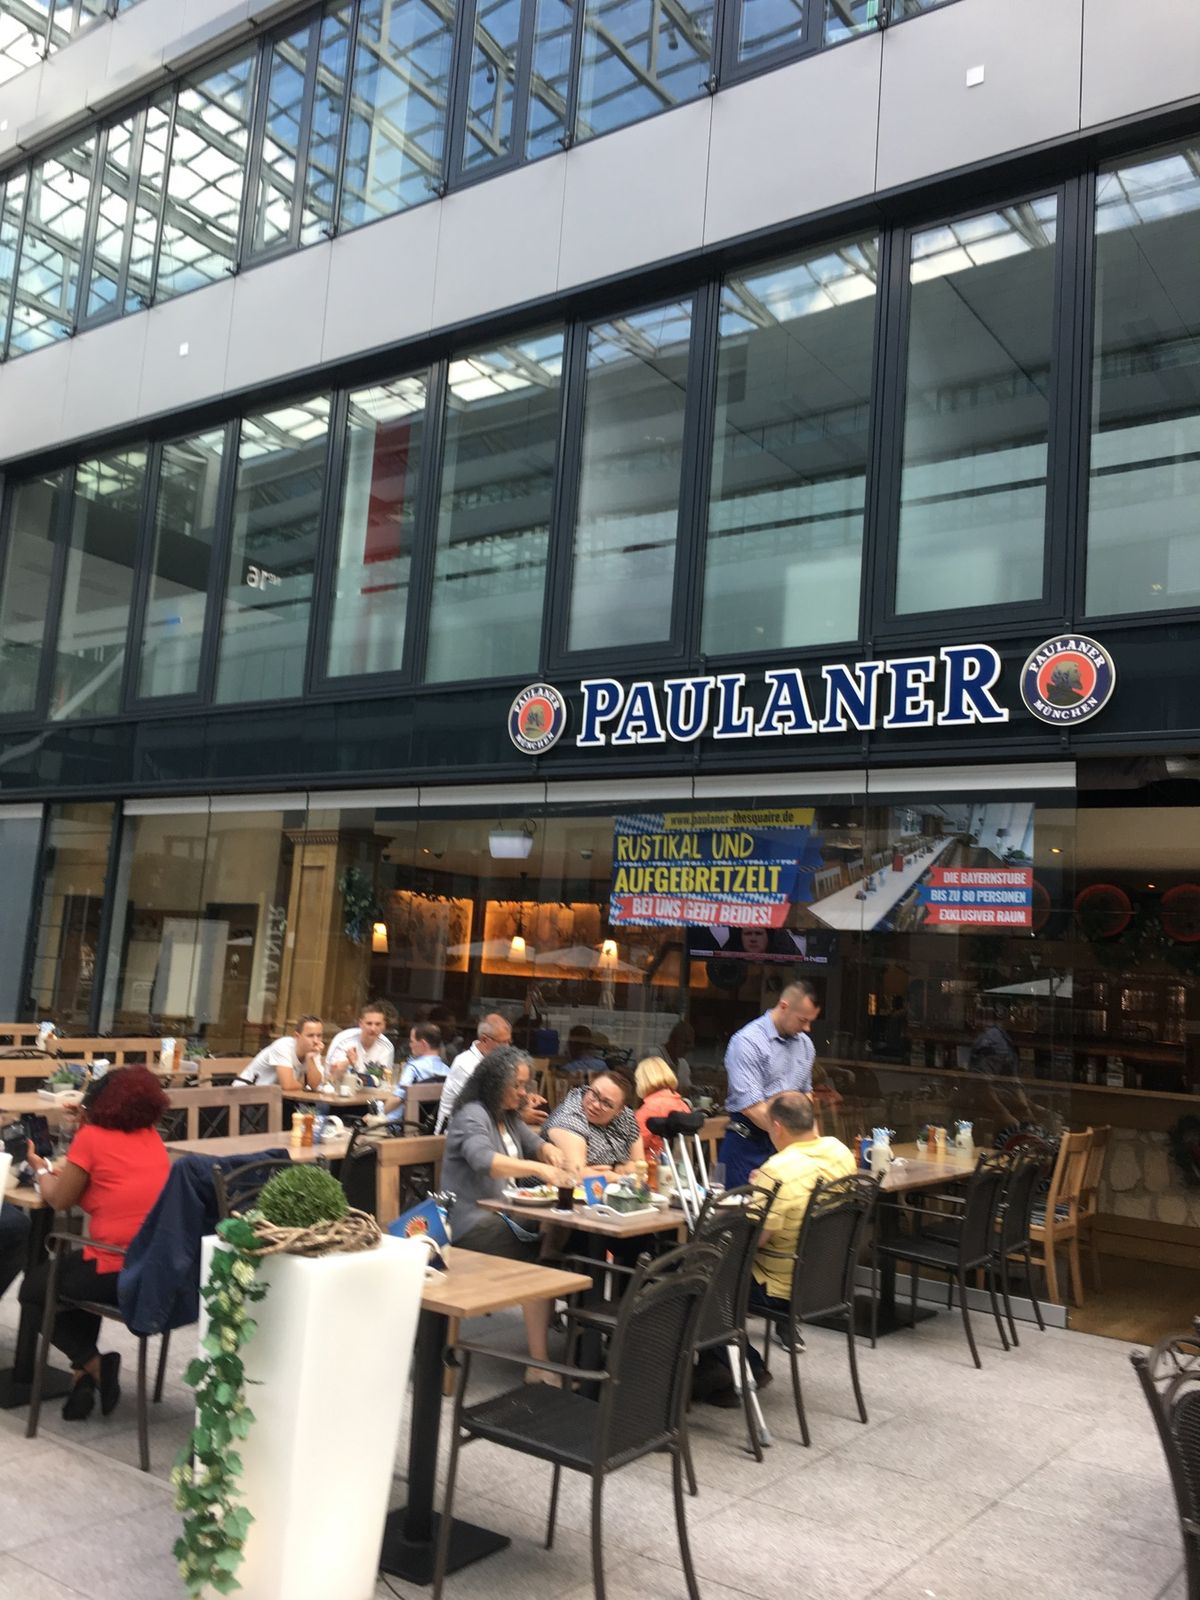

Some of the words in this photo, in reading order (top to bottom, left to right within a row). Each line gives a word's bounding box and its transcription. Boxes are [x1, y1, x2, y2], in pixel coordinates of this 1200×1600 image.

[1028, 640, 1106, 673] PAULANER
[514, 687, 560, 713] PAULANER
[576, 643, 1010, 747] PAULANER
[1033, 696, 1098, 720] MÜNCHEN
[617, 834, 702, 861] RUSTIKAL
[712, 832, 754, 858] UND
[614, 865, 782, 893] AUFGEBRETZELT
[943, 872, 958, 884] DIE
[960, 872, 1026, 884] BAYERNSTUBE
[931, 890, 946, 902] BIS
[948, 890, 960, 903] ZU
[976, 890, 1026, 904] PERSONEN
[632, 898, 652, 916] BEI
[656, 901, 681, 918] UNS
[683, 901, 718, 922] GEHT
[719, 903, 773, 925] BEIDES!
[939, 909, 994, 921] EXKLUSIVER
[997, 911, 1026, 923] RAUM
